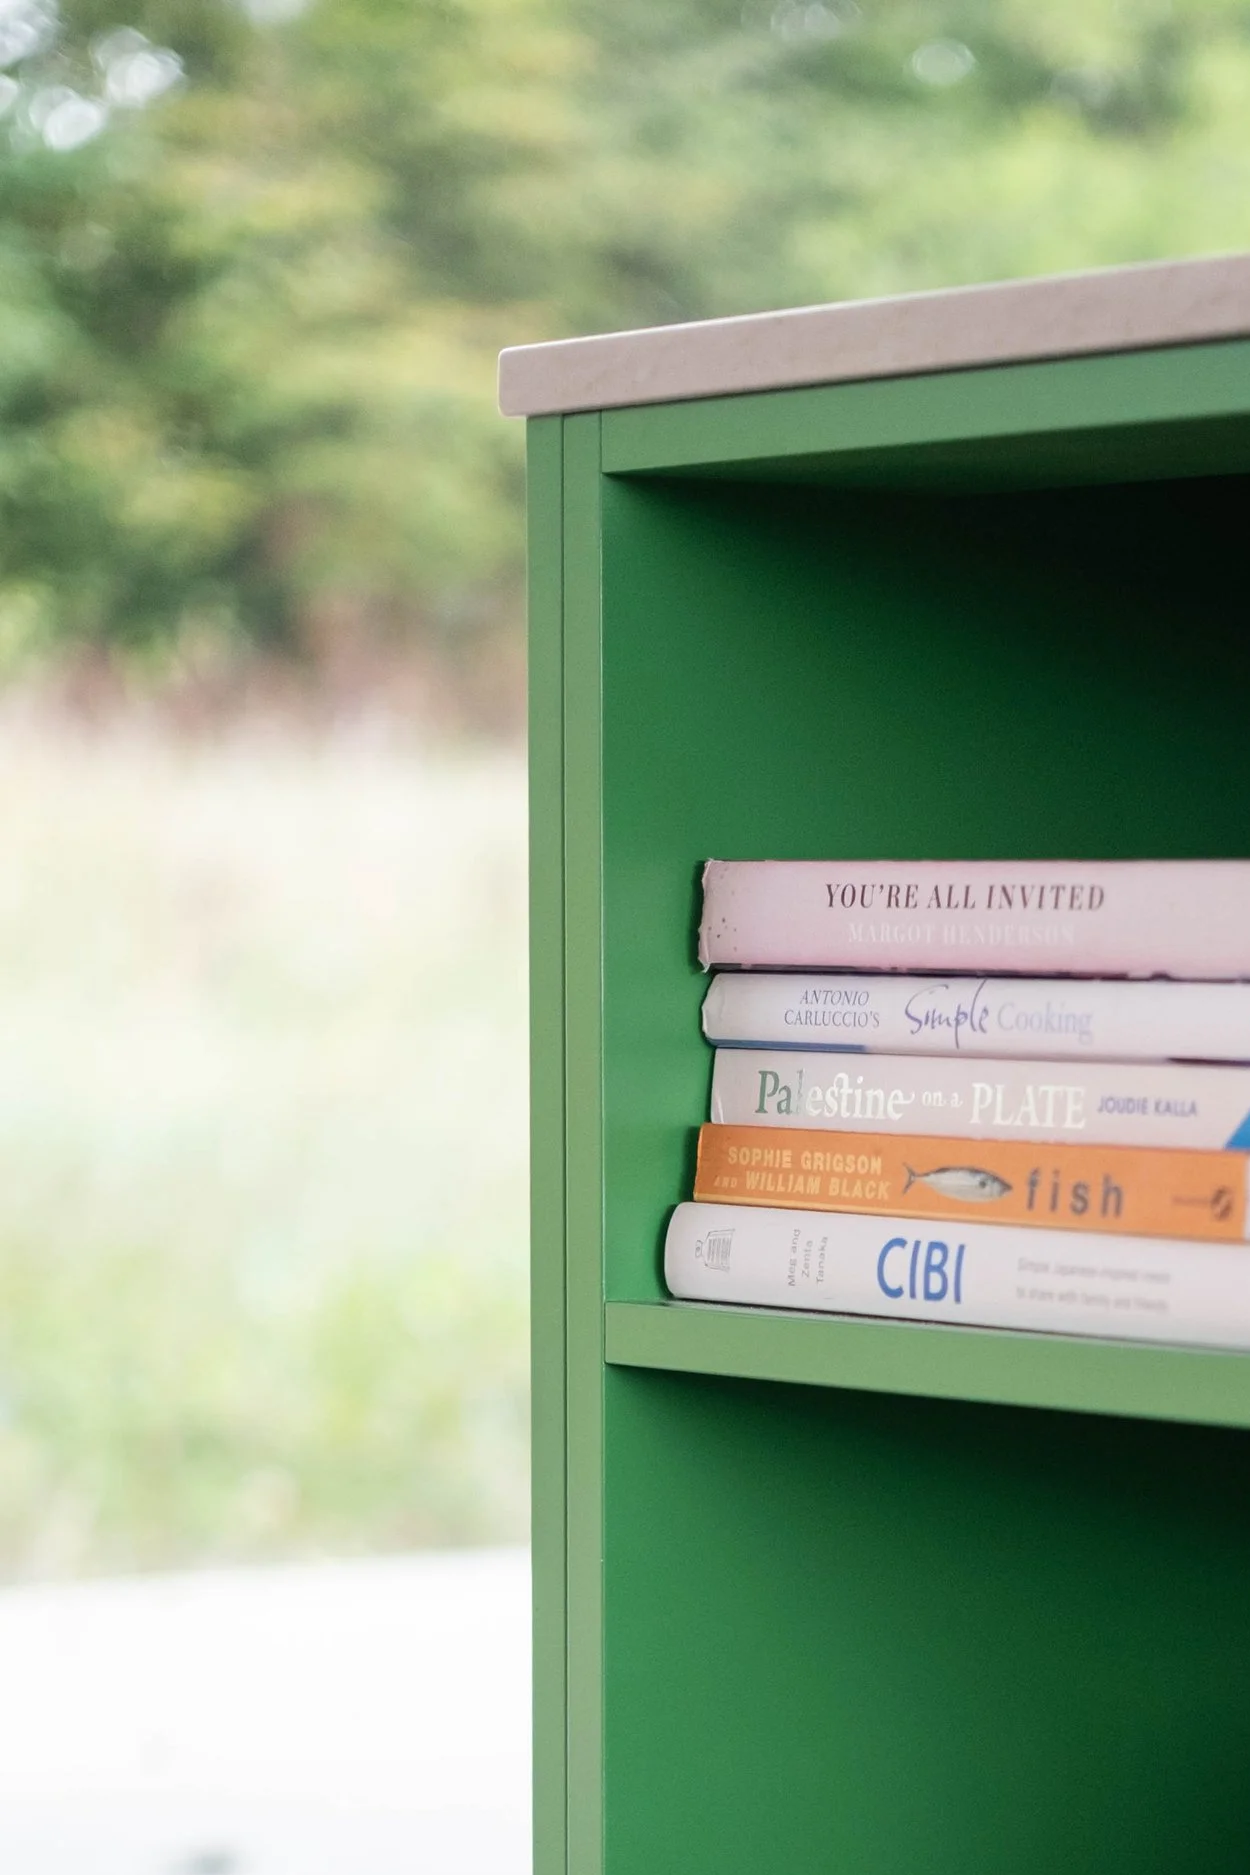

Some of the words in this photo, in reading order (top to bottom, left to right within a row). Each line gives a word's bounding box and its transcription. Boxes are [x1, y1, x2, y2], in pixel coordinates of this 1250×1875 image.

[926, 883, 976, 909] ALL
[986, 884, 1105, 911] INVITED
[848, 923, 935, 944] MARGOT
[942, 923, 1075, 946] HENDERSON
[799, 989, 870, 1007] ANTONIO
[783, 1008, 880, 1028] CARLUCCIO'S
[904, 978, 990, 1050] Simple
[997, 1003, 1094, 1044] Cooking
[755, 1068, 916, 1121] Palestine
[921, 1089, 946, 1108] on
[948, 1093, 963, 1108] a
[969, 1081, 1086, 1130] PLATE
[1098, 1096, 1149, 1116] JOUDIE
[1154, 1100, 1198, 1117] KALLA
[728, 1147, 794, 1169] SOPHIE
[801, 1151, 882, 1175] GRIGSON
[714, 1177, 738, 1189] AND
[745, 1170, 821, 1195] WILLIAM
[828, 1178, 890, 1200] BLACK
[1024, 1167, 1124, 1219] fish
[791, 1228, 801, 1254] and
[787, 1256, 799, 1288] Meg
[801, 1240, 813, 1279] Zenta
[816, 1235, 829, 1285] Tanaka
[876, 1236, 967, 1305] CIBI
